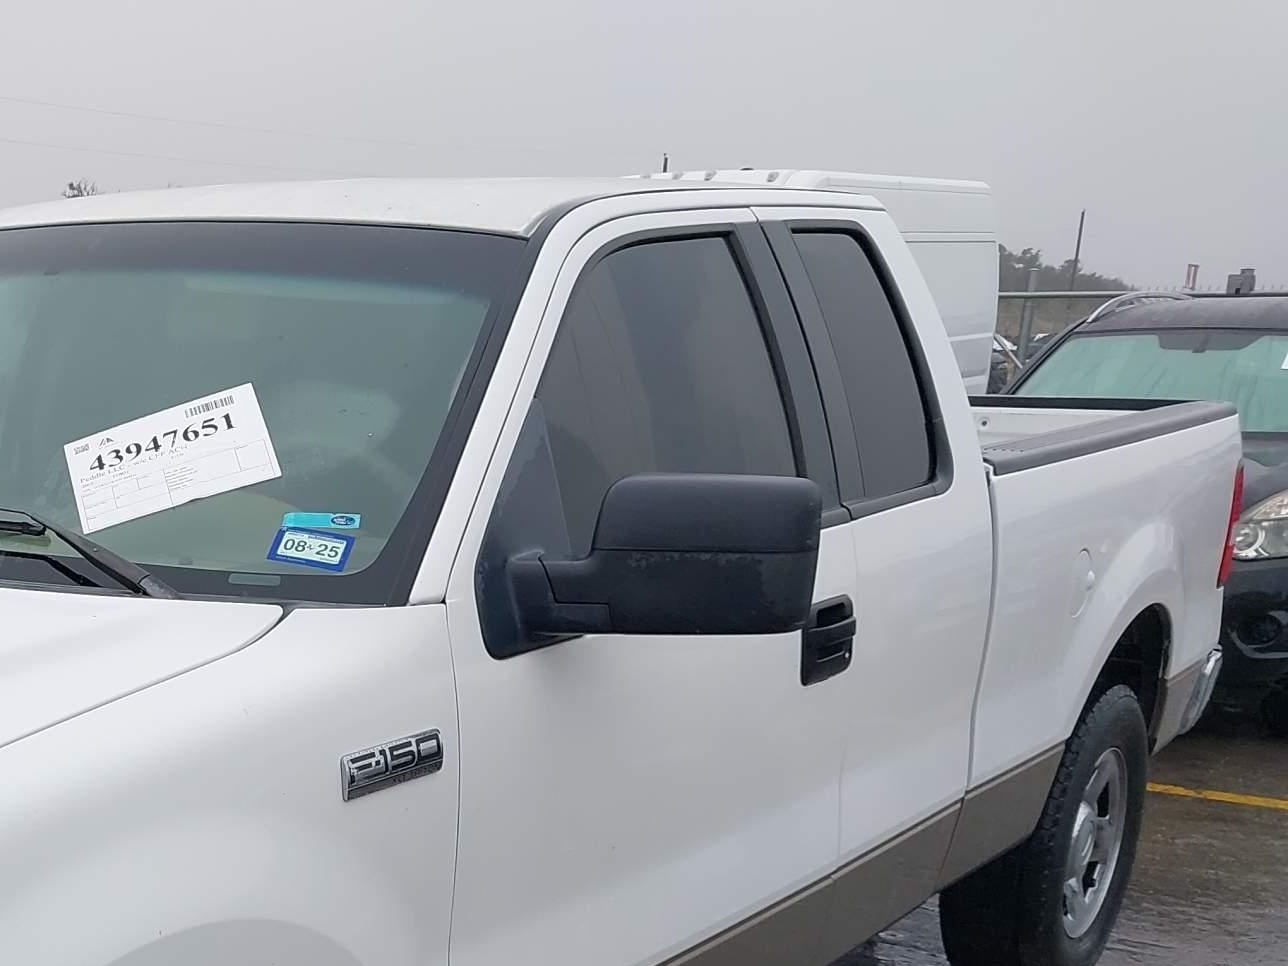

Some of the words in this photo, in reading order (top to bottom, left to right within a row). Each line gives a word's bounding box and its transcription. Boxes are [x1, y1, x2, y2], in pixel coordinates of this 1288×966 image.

[88, 411, 238, 471] 43947651
[283, 538, 308, 553] 08
[315, 543, 341, 558] 25
